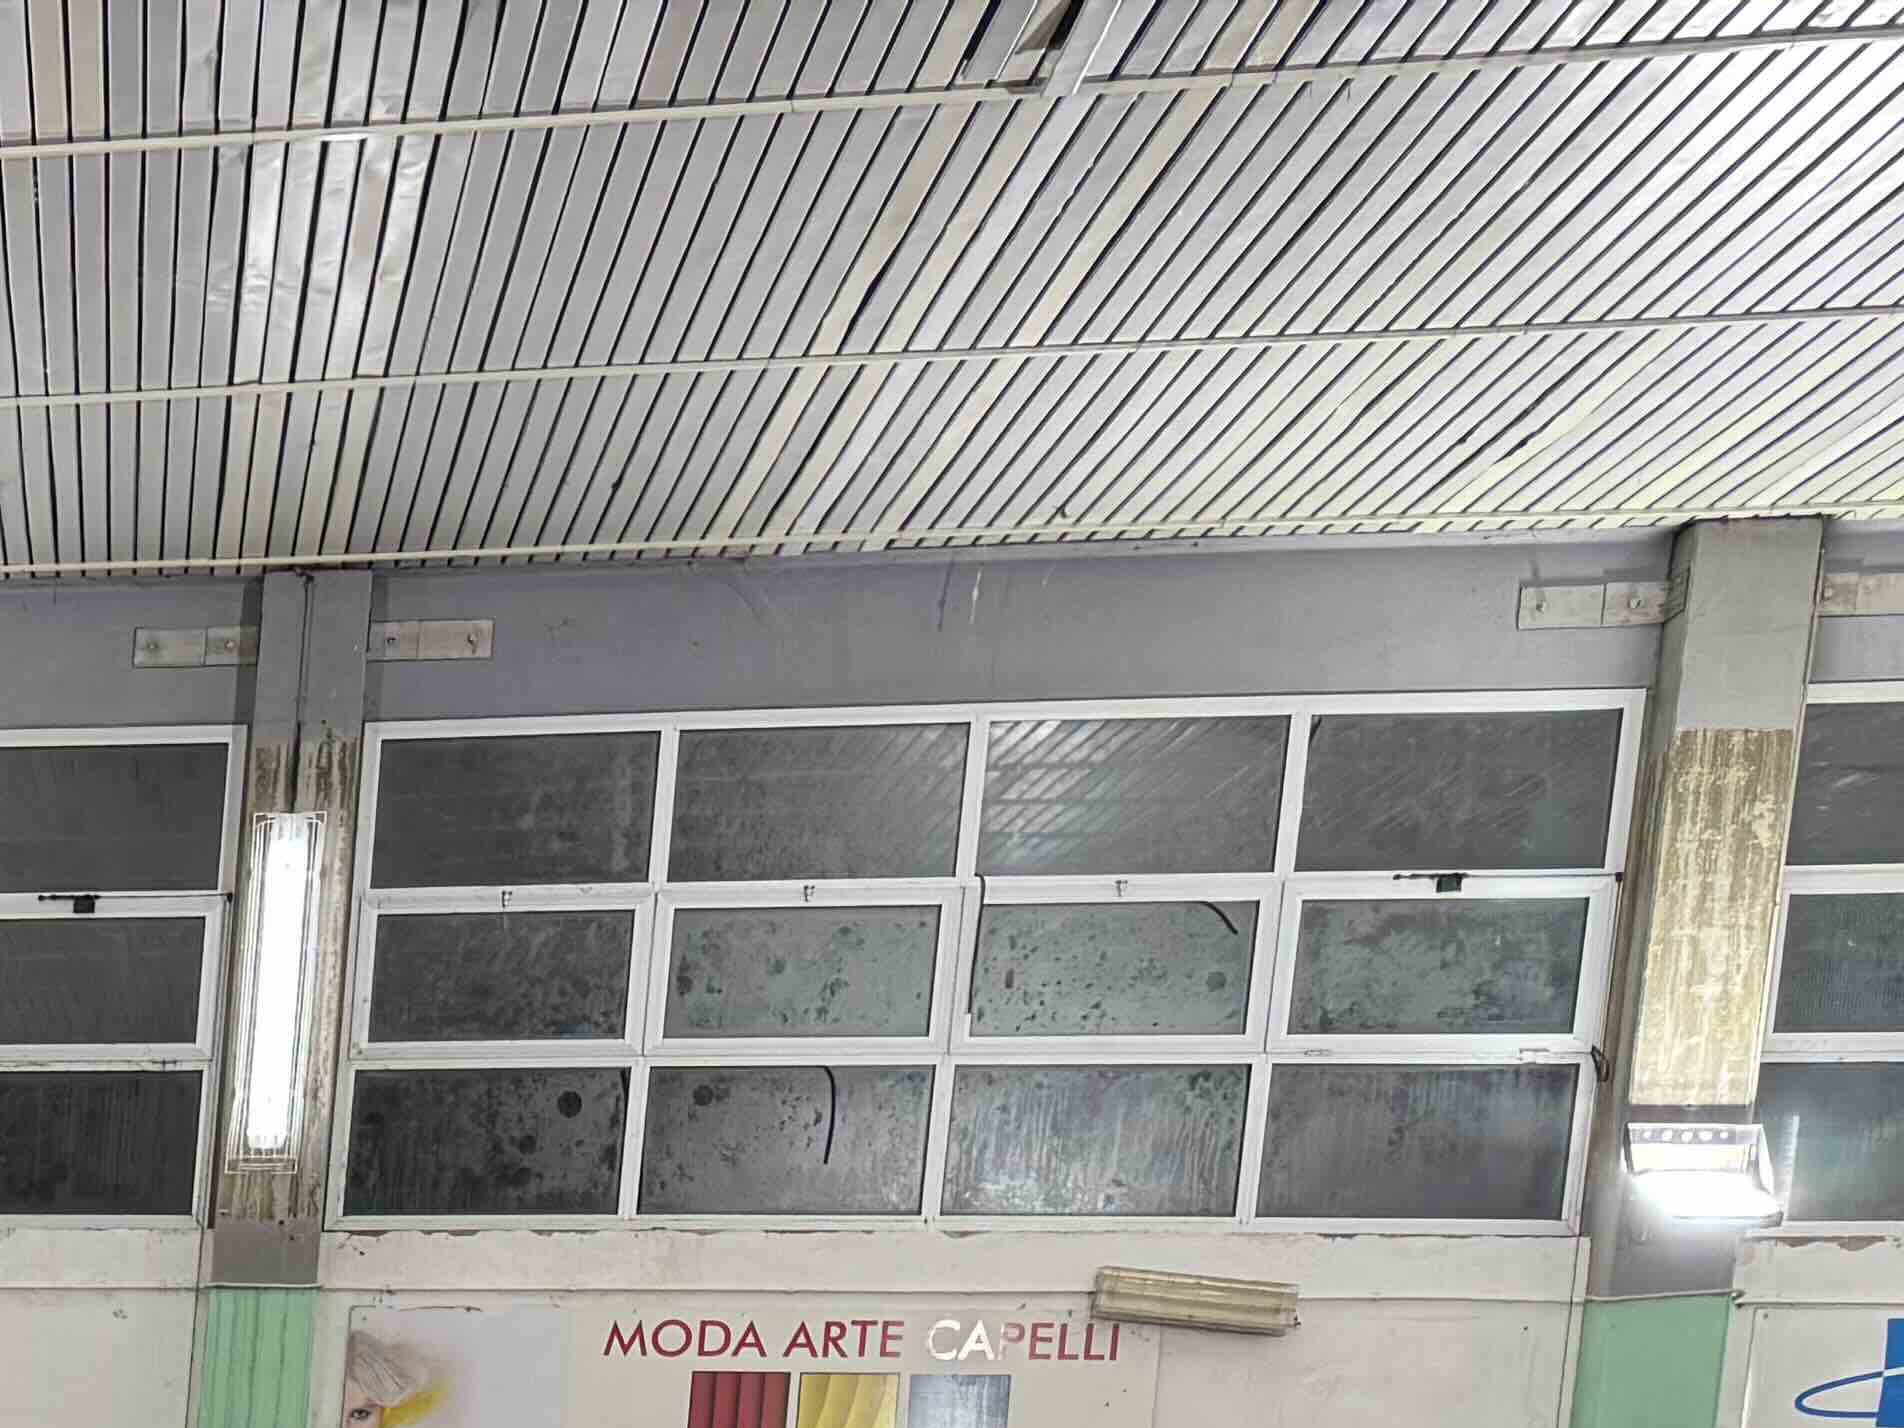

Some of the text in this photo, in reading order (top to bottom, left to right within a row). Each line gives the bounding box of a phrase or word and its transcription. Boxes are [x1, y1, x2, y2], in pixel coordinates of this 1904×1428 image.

[603, 1320, 1121, 1361] MODA ARTE CAPELLI
